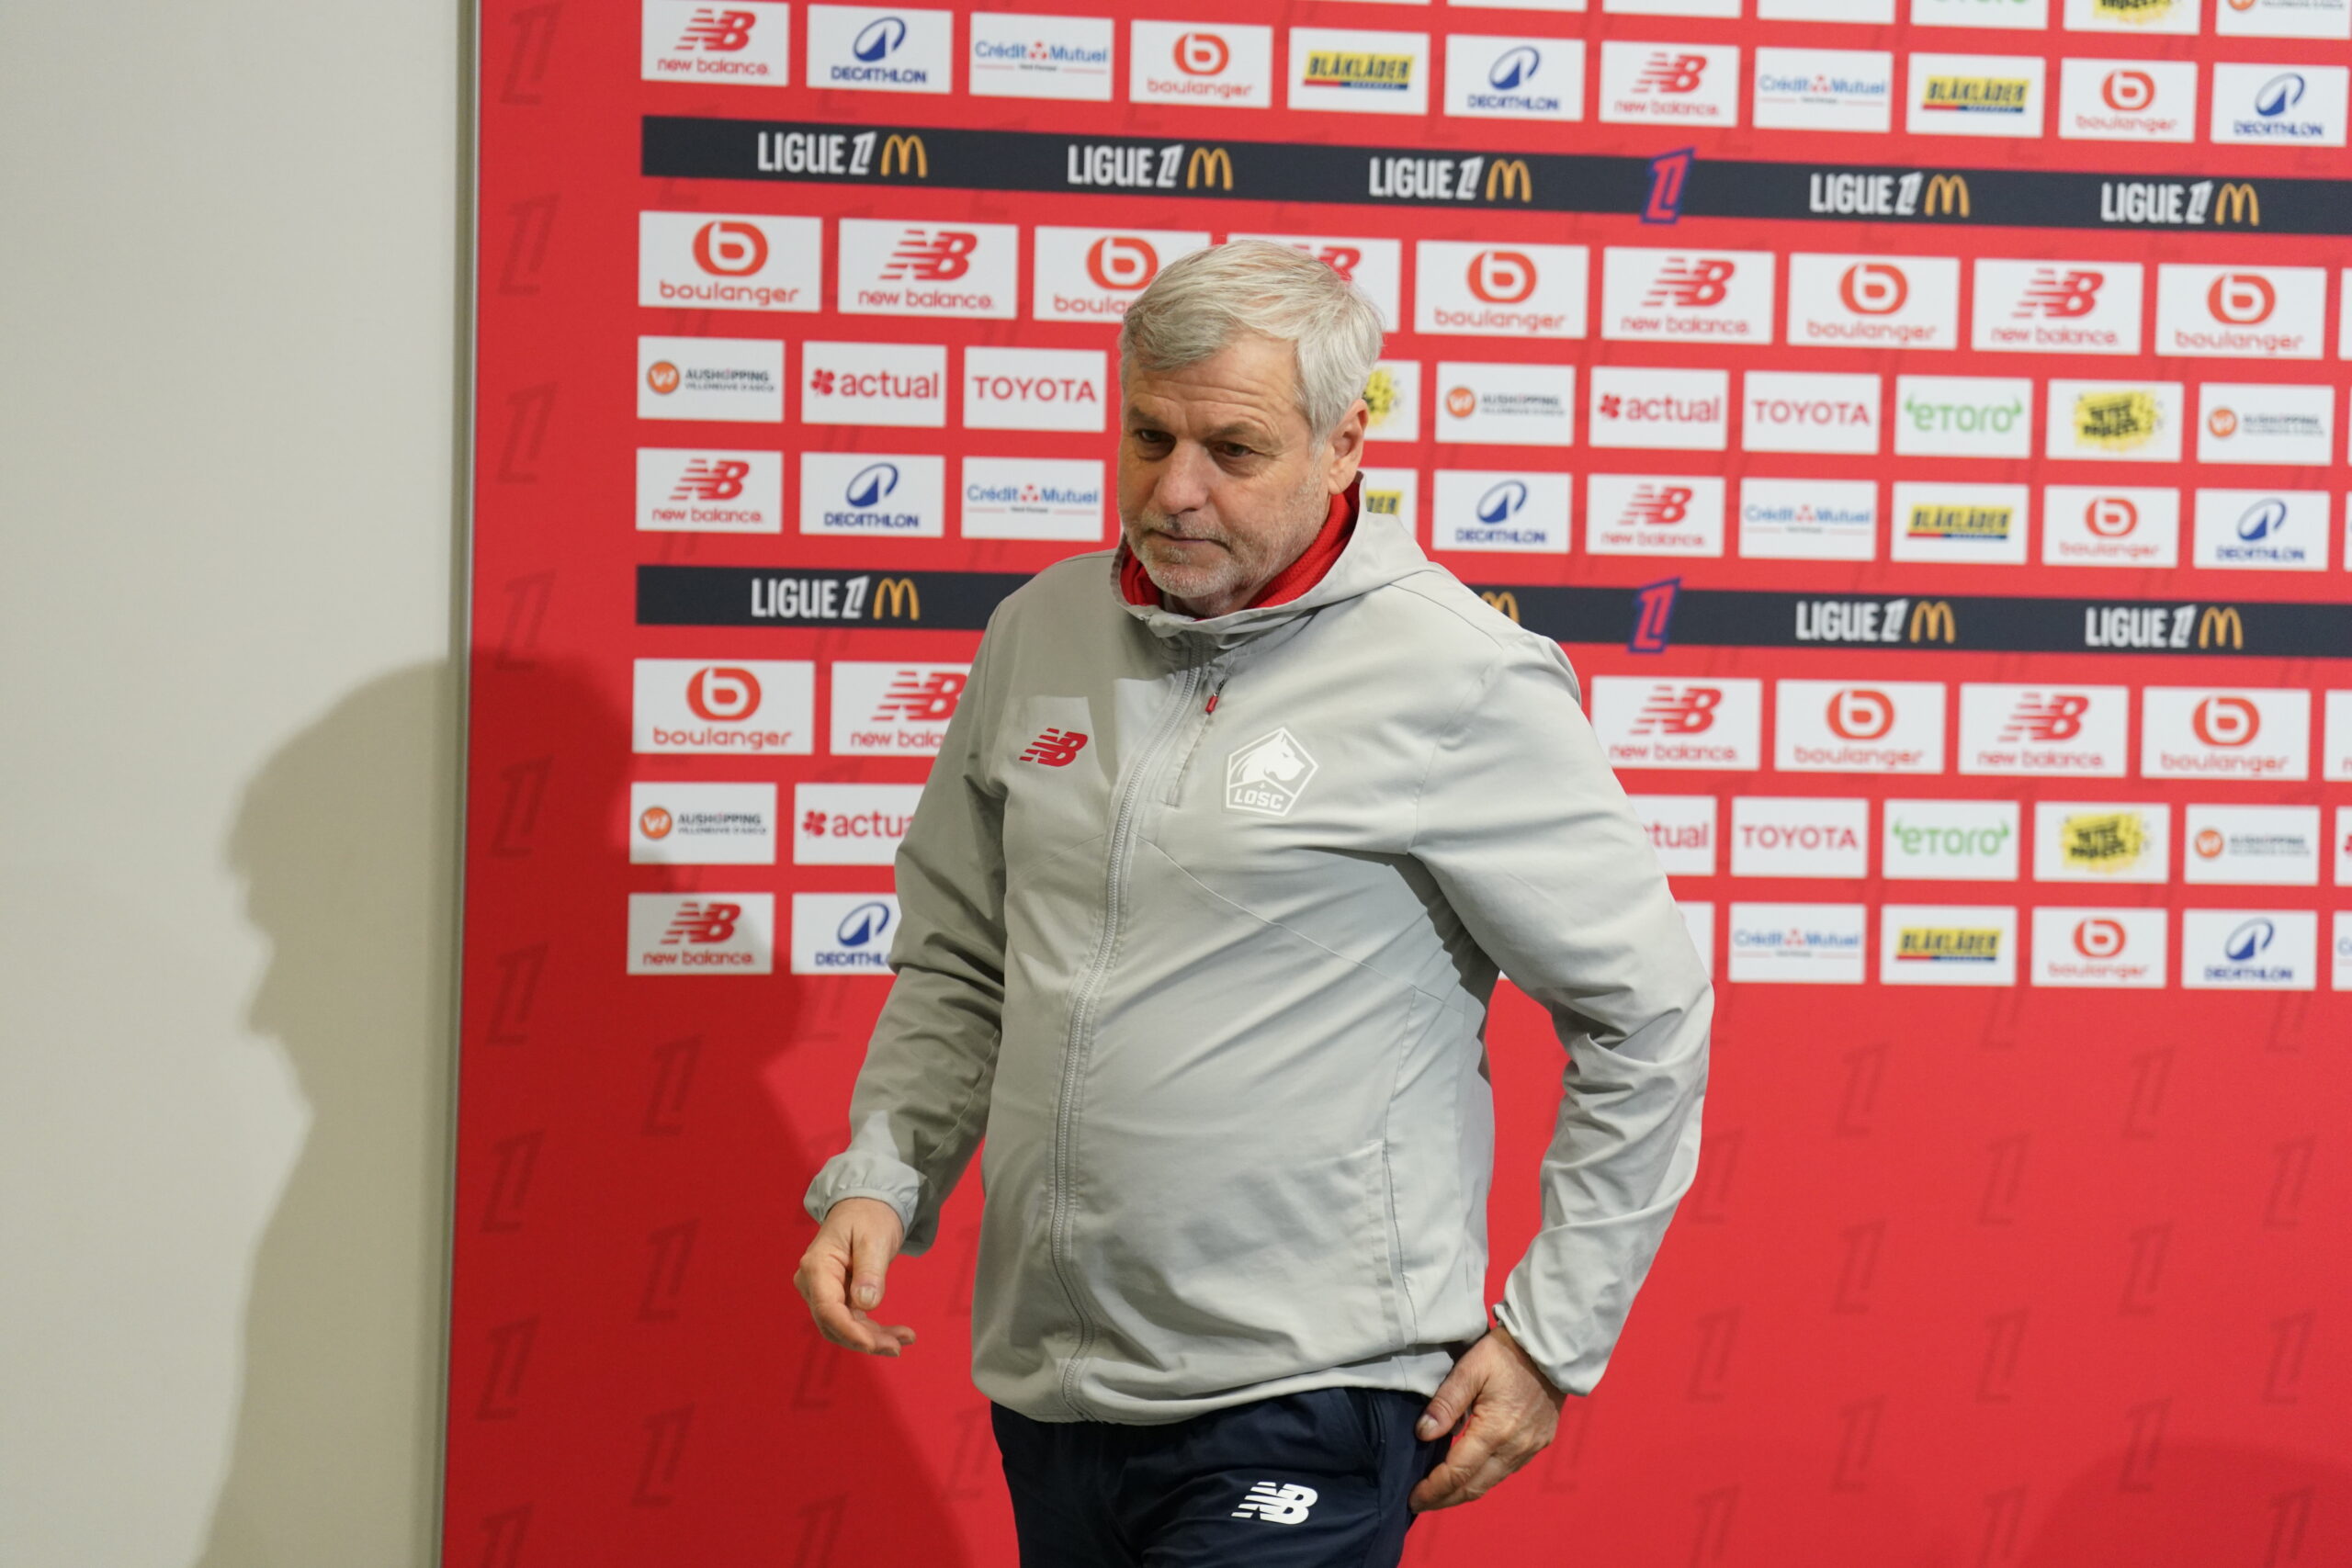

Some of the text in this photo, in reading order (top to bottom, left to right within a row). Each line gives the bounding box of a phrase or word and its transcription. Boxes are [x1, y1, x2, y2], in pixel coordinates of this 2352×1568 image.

[975, 40, 1107, 62] Crédit Mutuel
[658, 59, 693, 72] new
[831, 66, 926, 83] DECATHLON
[1148, 79, 1252, 99] boulanger
[1759, 75, 1886, 95] Crédit Mutuel
[1468, 95, 1559, 110] DECATHLON
[1615, 101, 1647, 113] new
[2075, 115, 2177, 134] boulanger
[758, 132, 846, 174] LIGUE
[1068, 145, 1154, 186] LIGUE
[1369, 157, 1454, 199] LIGUE
[1810, 174, 1894, 214] LIGUE
[2101, 183, 2184, 223] LIGUE
[660, 279, 799, 306] boulanger
[858, 290, 900, 306] new
[1055, 294, 1128, 314] boula
[1435, 307, 1565, 334] boulanger
[1622, 316, 1661, 332] new
[1807, 319, 1936, 344] boulanger
[1992, 328, 2030, 343] new
[2176, 329, 2303, 354] boulanger
[840, 370, 939, 399] actual
[972, 376, 1097, 402] TOYOTA
[1625, 395, 1720, 423] actual
[1753, 400, 1870, 426] TOYOTA
[967, 485, 1098, 504] Crédit Mutuel
[652, 509, 686, 521] new
[824, 513, 919, 527] DECATHLON
[1745, 505, 1871, 524] Crédit Mutuel
[1455, 529, 1546, 544] DECATHLON
[1601, 533, 1634, 545] new
[752, 579, 838, 618] LIGUE
[1796, 602, 1882, 641] LIGUE
[2086, 607, 2171, 648] LIGUE
[654, 728, 791, 749] boulanger
[851, 732, 892, 747] new
[1019, 728, 1089, 767] NB
[1610, 745, 1648, 760] new
[1795, 746, 1923, 769] boulanger
[1978, 751, 2018, 766] new
[2162, 752, 2289, 774] boulanger
[1234, 788, 1283, 809] LOSC
[831, 811, 902, 838] actu
[1652, 823, 1708, 849] tual
[1741, 825, 1859, 850] TOYOTA
[643, 953, 678, 965] new
[816, 952, 888, 967] DECATHL
[1231, 1482, 1317, 1524] NB
